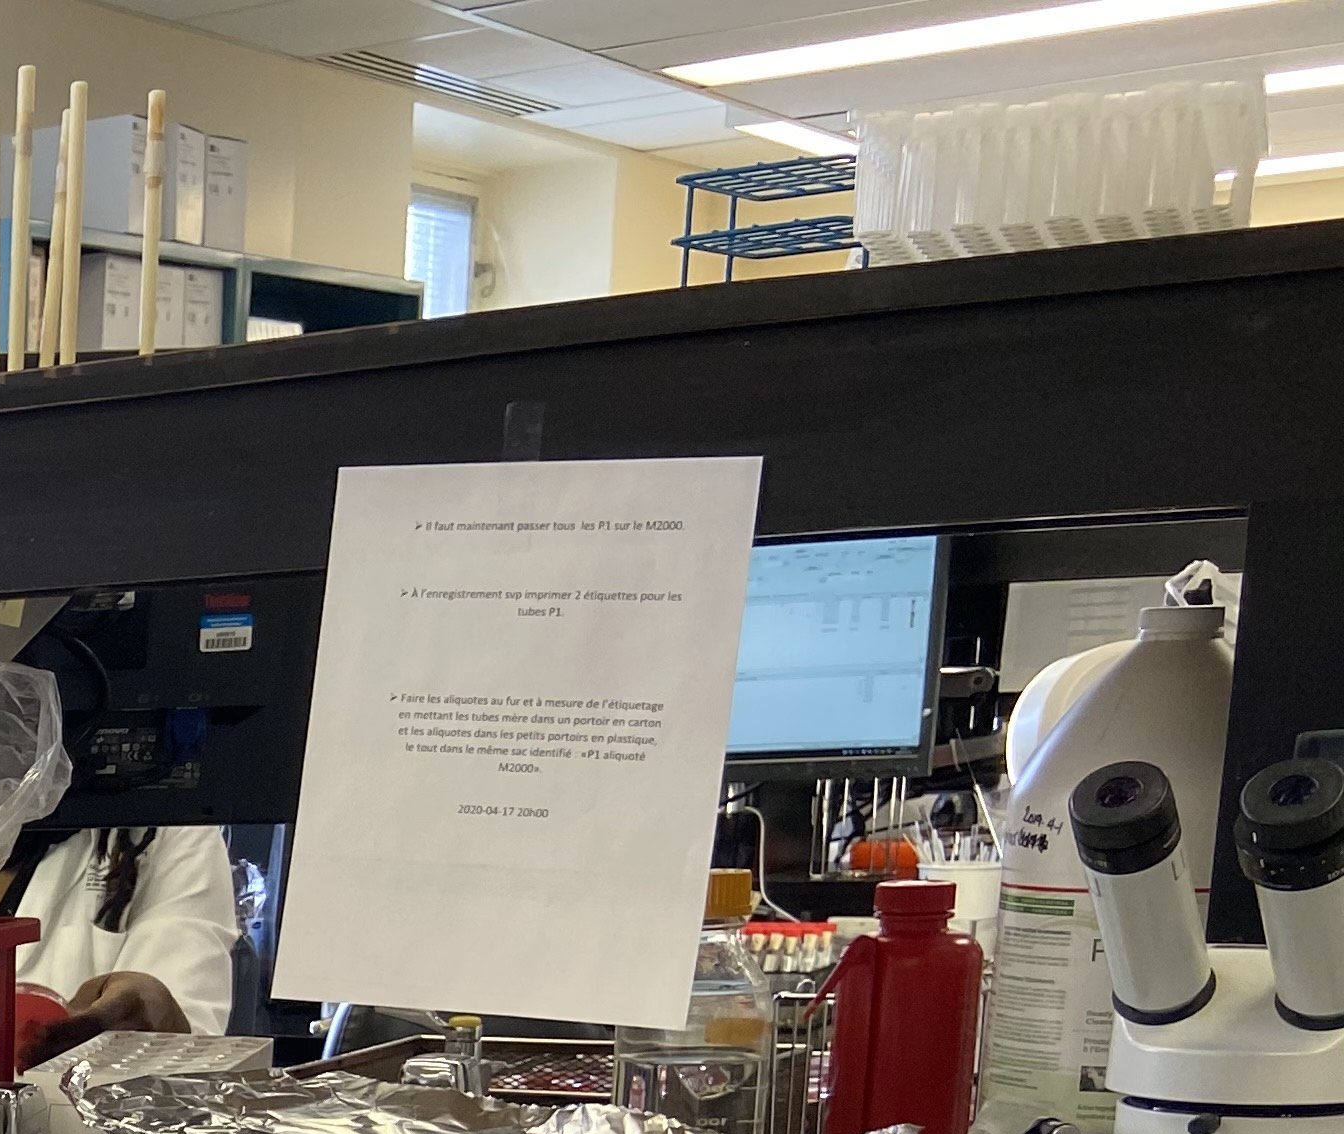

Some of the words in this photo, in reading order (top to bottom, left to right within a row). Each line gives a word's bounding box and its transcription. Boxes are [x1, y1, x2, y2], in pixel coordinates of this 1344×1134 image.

[434, 521, 454, 532] faut
[456, 521, 515, 532] maintenant
[517, 522, 550, 534] passer
[553, 522, 575, 532] tous
[581, 521, 595, 531] les
[614, 523, 630, 532] sur
[633, 521, 643, 531] le
[505, 591, 522, 601] svp
[524, 589, 572, 601] imprimer
[574, 590, 582, 600] 2
[640, 592, 665, 603] pour
[668, 591, 682, 601] les
[517, 607, 547, 617] tubes
[401, 694, 425, 703] Faire
[427, 694, 441, 704] les
[443, 695, 489, 706] aliquotes
[491, 697, 503, 706] au
[506, 696, 521, 706] fur
[545, 699, 583, 709] mesure
[586, 699, 600, 709] de
[398, 711, 411, 719] en
[413, 711, 453, 721] mettant
[455, 711, 469, 721] les
[471, 712, 499, 722] tubes
[531, 714, 555, 724] dans
[557, 716, 571, 724] un
[573, 716, 610, 727] portoir
[613, 717, 625, 726] en
[628, 718, 661, 728] carton
[410, 726, 425, 736] les
[427, 727, 472, 739] aliquotes
[474, 729, 498, 739] dans
[500, 729, 514, 739] les
[516, 730, 545, 742] petits
[547, 731, 588, 743] portoirs
[591, 734, 604, 743] en
[416, 743, 438, 753] tout
[439, 743, 463, 753] dans
[465, 744, 475, 754] le
[511, 748, 527, 756] sac
[457, 805, 515, 817] 2020-04-17
